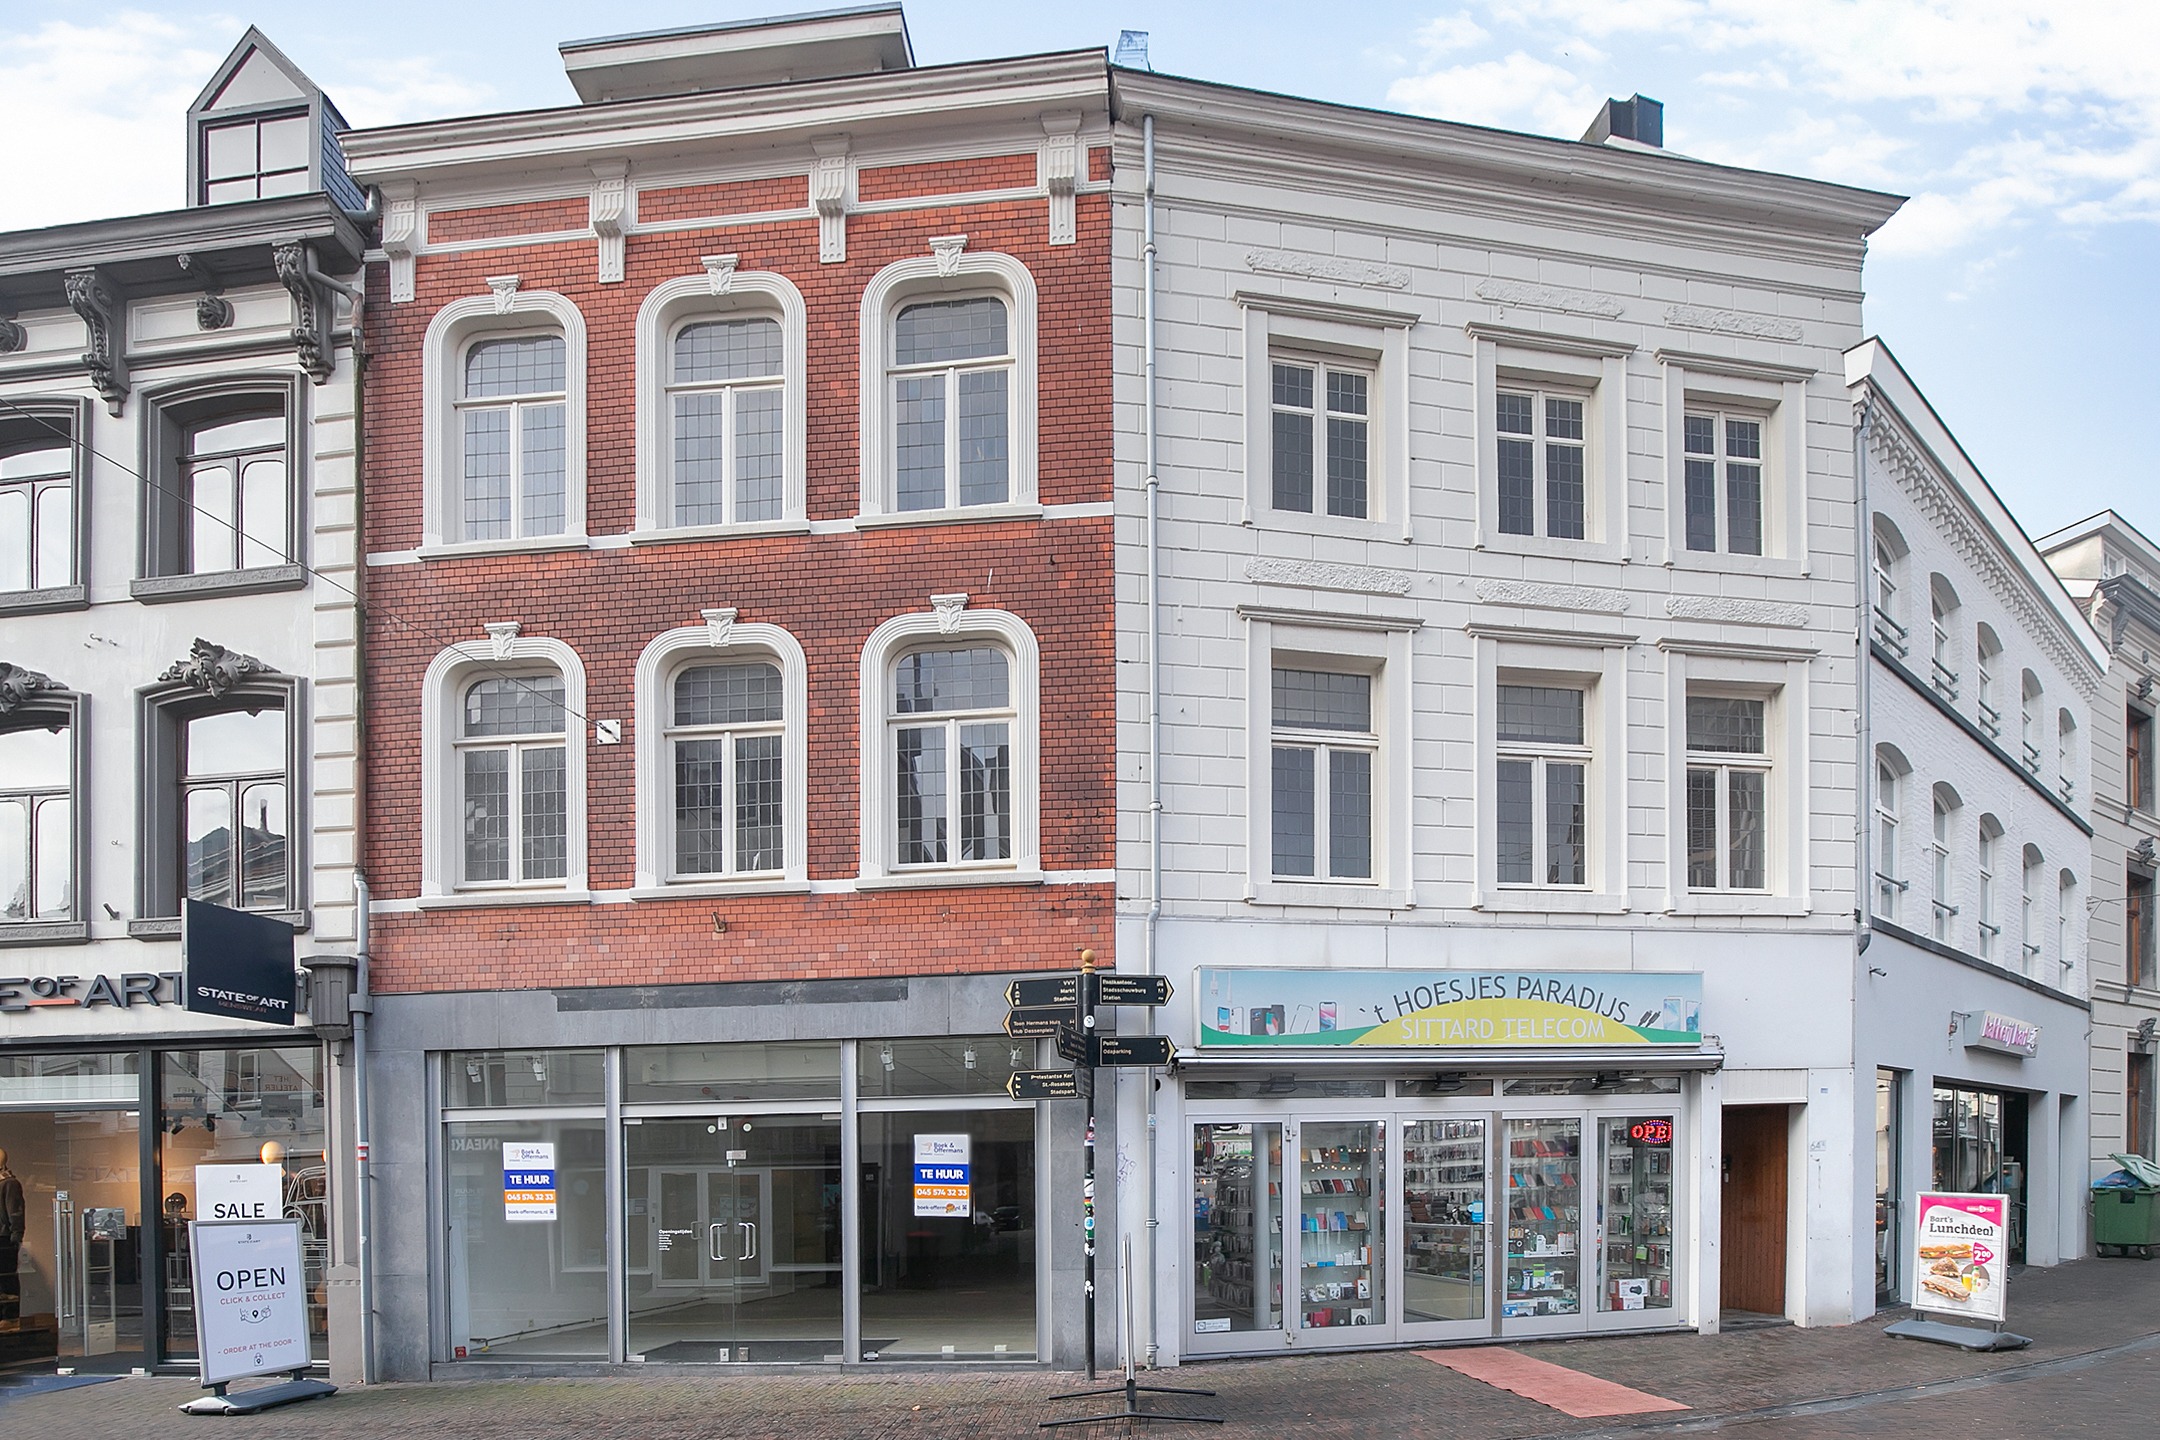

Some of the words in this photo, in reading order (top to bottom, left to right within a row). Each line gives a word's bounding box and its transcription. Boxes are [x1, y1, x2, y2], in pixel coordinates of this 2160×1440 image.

[30, 975, 79, 997] OF
[198, 986, 246, 1003] STATE
[259, 998, 288, 1010] ART
[1393, 975, 1506, 1018] HOESJES
[1516, 976, 1630, 1023] PARADIJS
[1401, 1017, 1495, 1040] SITTARD
[1501, 1017, 1606, 1039] TELECOM
[1631, 1124, 1672, 1138] OPE
[510, 1175, 522, 1184] TE
[524, 1175, 550, 1184] HUUR
[920, 1169, 933, 1179] TE
[936, 1169, 964, 1179] HUUR
[214, 1203, 266, 1219] SALE
[1929, 1223, 1993, 1236] Lunchdeal
[216, 1267, 285, 1291] OPEN
[220, 1296, 243, 1305] CLICK
[252, 1292, 286, 1302] COLLECT
[223, 1346, 246, 1354] ORDER
[274, 1339, 292, 1347] DOOR
